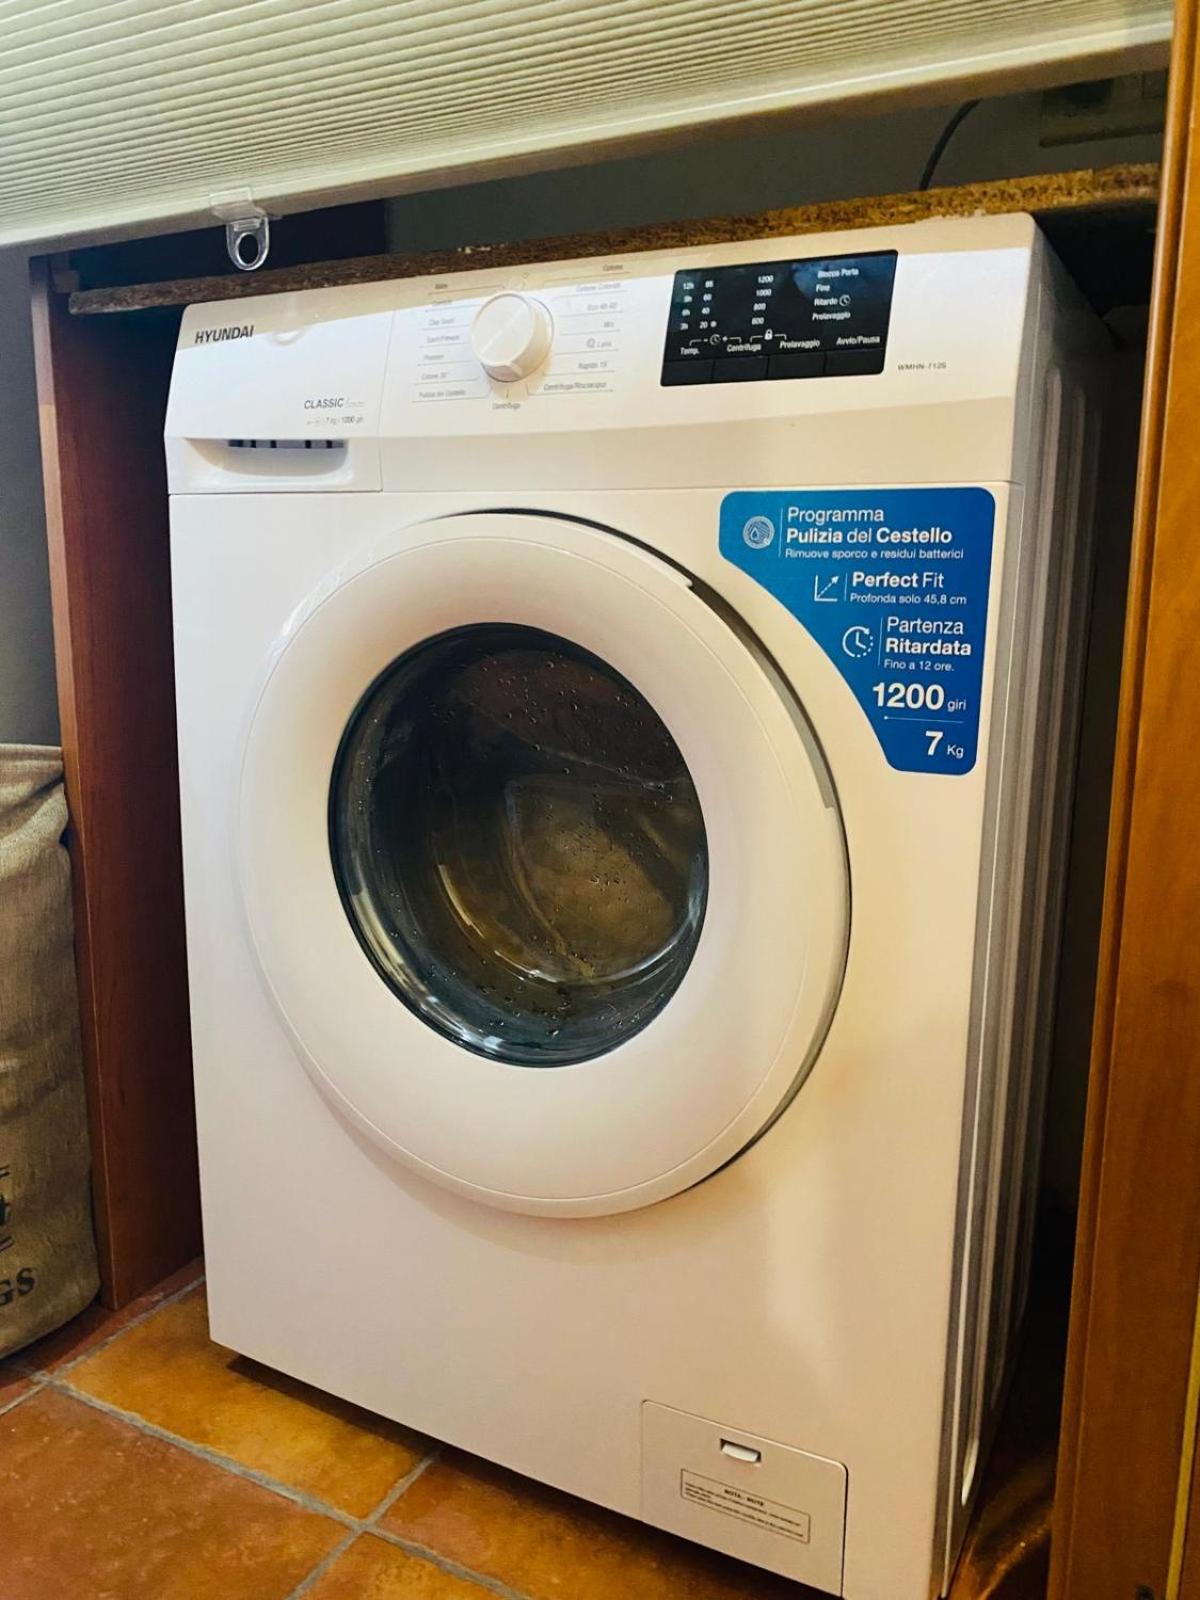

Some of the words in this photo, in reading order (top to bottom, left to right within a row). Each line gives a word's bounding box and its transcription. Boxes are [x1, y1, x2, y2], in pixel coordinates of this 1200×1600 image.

[841, 267, 859, 277] Porta
[757, 275, 774, 284] 1200
[756, 288, 772, 297] 1000
[815, 283, 830, 293] Fine
[814, 296, 838, 306] Ritardo
[194, 325, 255, 344] HYUNDAI
[836, 334, 881, 346] Avvio/Pausa
[680, 346, 700, 356] Temp.
[304, 398, 344, 410] CLASSIC
[787, 506, 885, 525] Programma
[786, 527, 843, 544] Pulizia
[847, 527, 872, 543] del
[876, 527, 953, 544] Cestello
[785, 548, 830, 559] Rimuove
[831, 549, 868, 560] sporco
[870, 550, 878, 559] e
[880, 548, 916, 559] residui
[918, 548, 964, 559] batterici
[852, 571, 918, 588] Perfect
[922, 572, 945, 588] Fit
[849, 592, 897, 604] Profonda
[898, 593, 921, 604] solo
[923, 593, 947, 606] 45,8
[949, 596, 967, 605] cm
[887, 616, 964, 635] Partenza
[885, 638, 972, 656] Ritardata
[883, 658, 906, 670] Fino
[908, 661, 916, 670] a
[919, 660, 931, 671] 12
[933, 662, 955, 671] ore.
[872, 682, 945, 710] 1200
[947, 699, 966, 712] giri
[925, 730, 944, 756] 7
[947, 744, 964, 759] Kg
